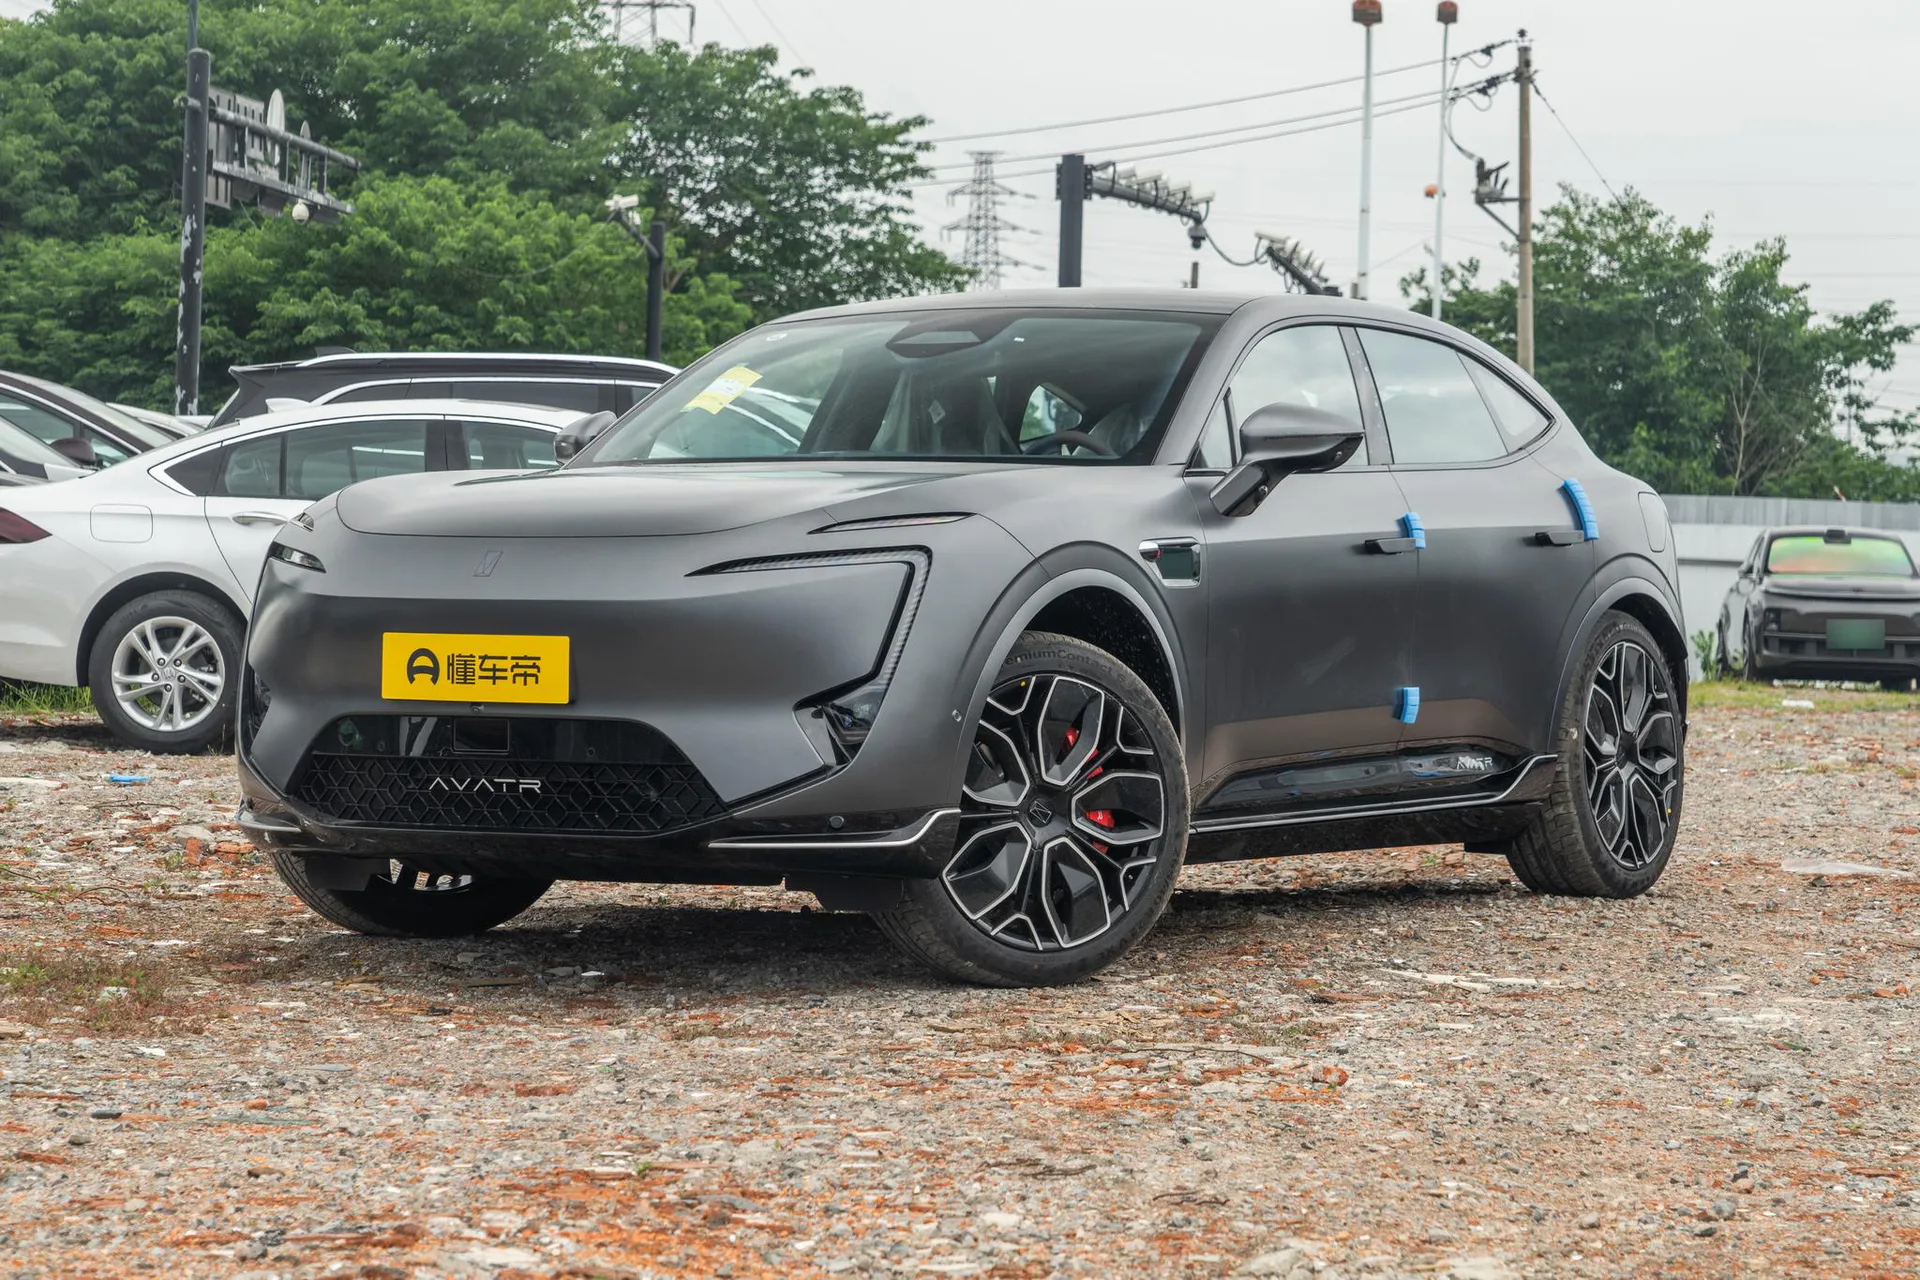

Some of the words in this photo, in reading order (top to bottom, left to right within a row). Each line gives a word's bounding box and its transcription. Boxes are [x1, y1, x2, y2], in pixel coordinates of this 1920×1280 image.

[447, 653, 541, 686] 懂车帝
[1004, 649, 1113, 676] emiumContact
[429, 777, 541, 793] AVATR
